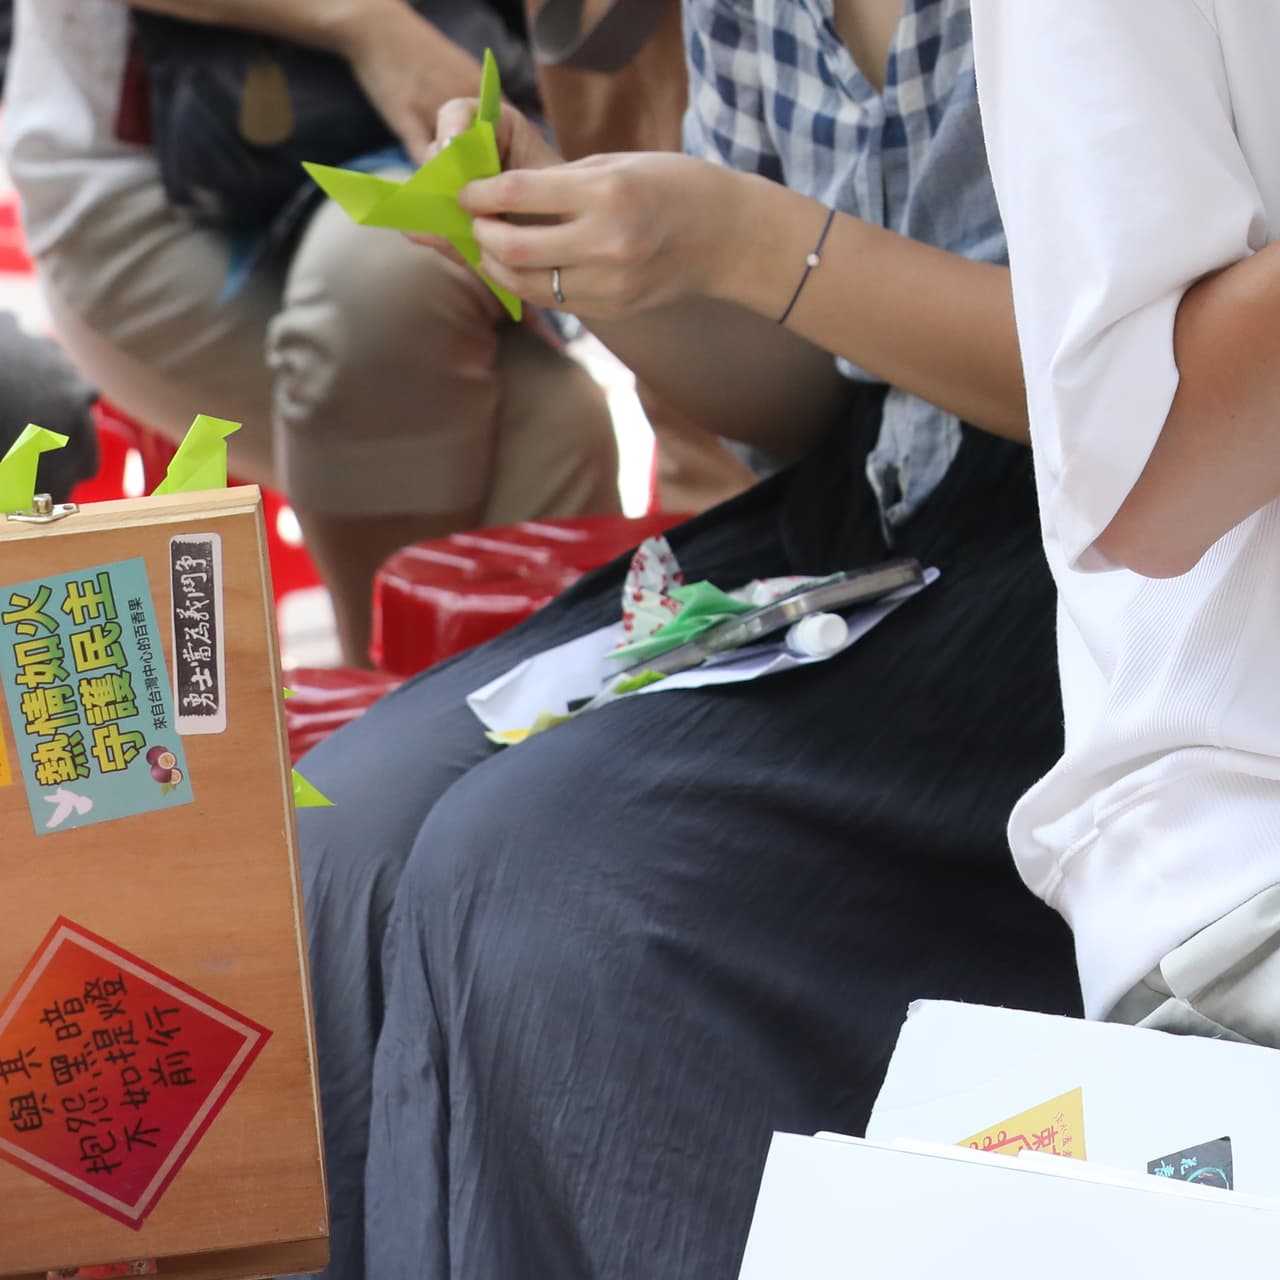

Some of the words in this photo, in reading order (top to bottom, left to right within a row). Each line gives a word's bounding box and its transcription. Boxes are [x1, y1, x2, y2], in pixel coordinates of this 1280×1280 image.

[1, 584, 91, 786] 熱情如火
[61, 571, 147, 774] 守護民主
[128, 596, 168, 731] 來自台灣中心的百香果
[146, 1004, 198, 1088] 前行
